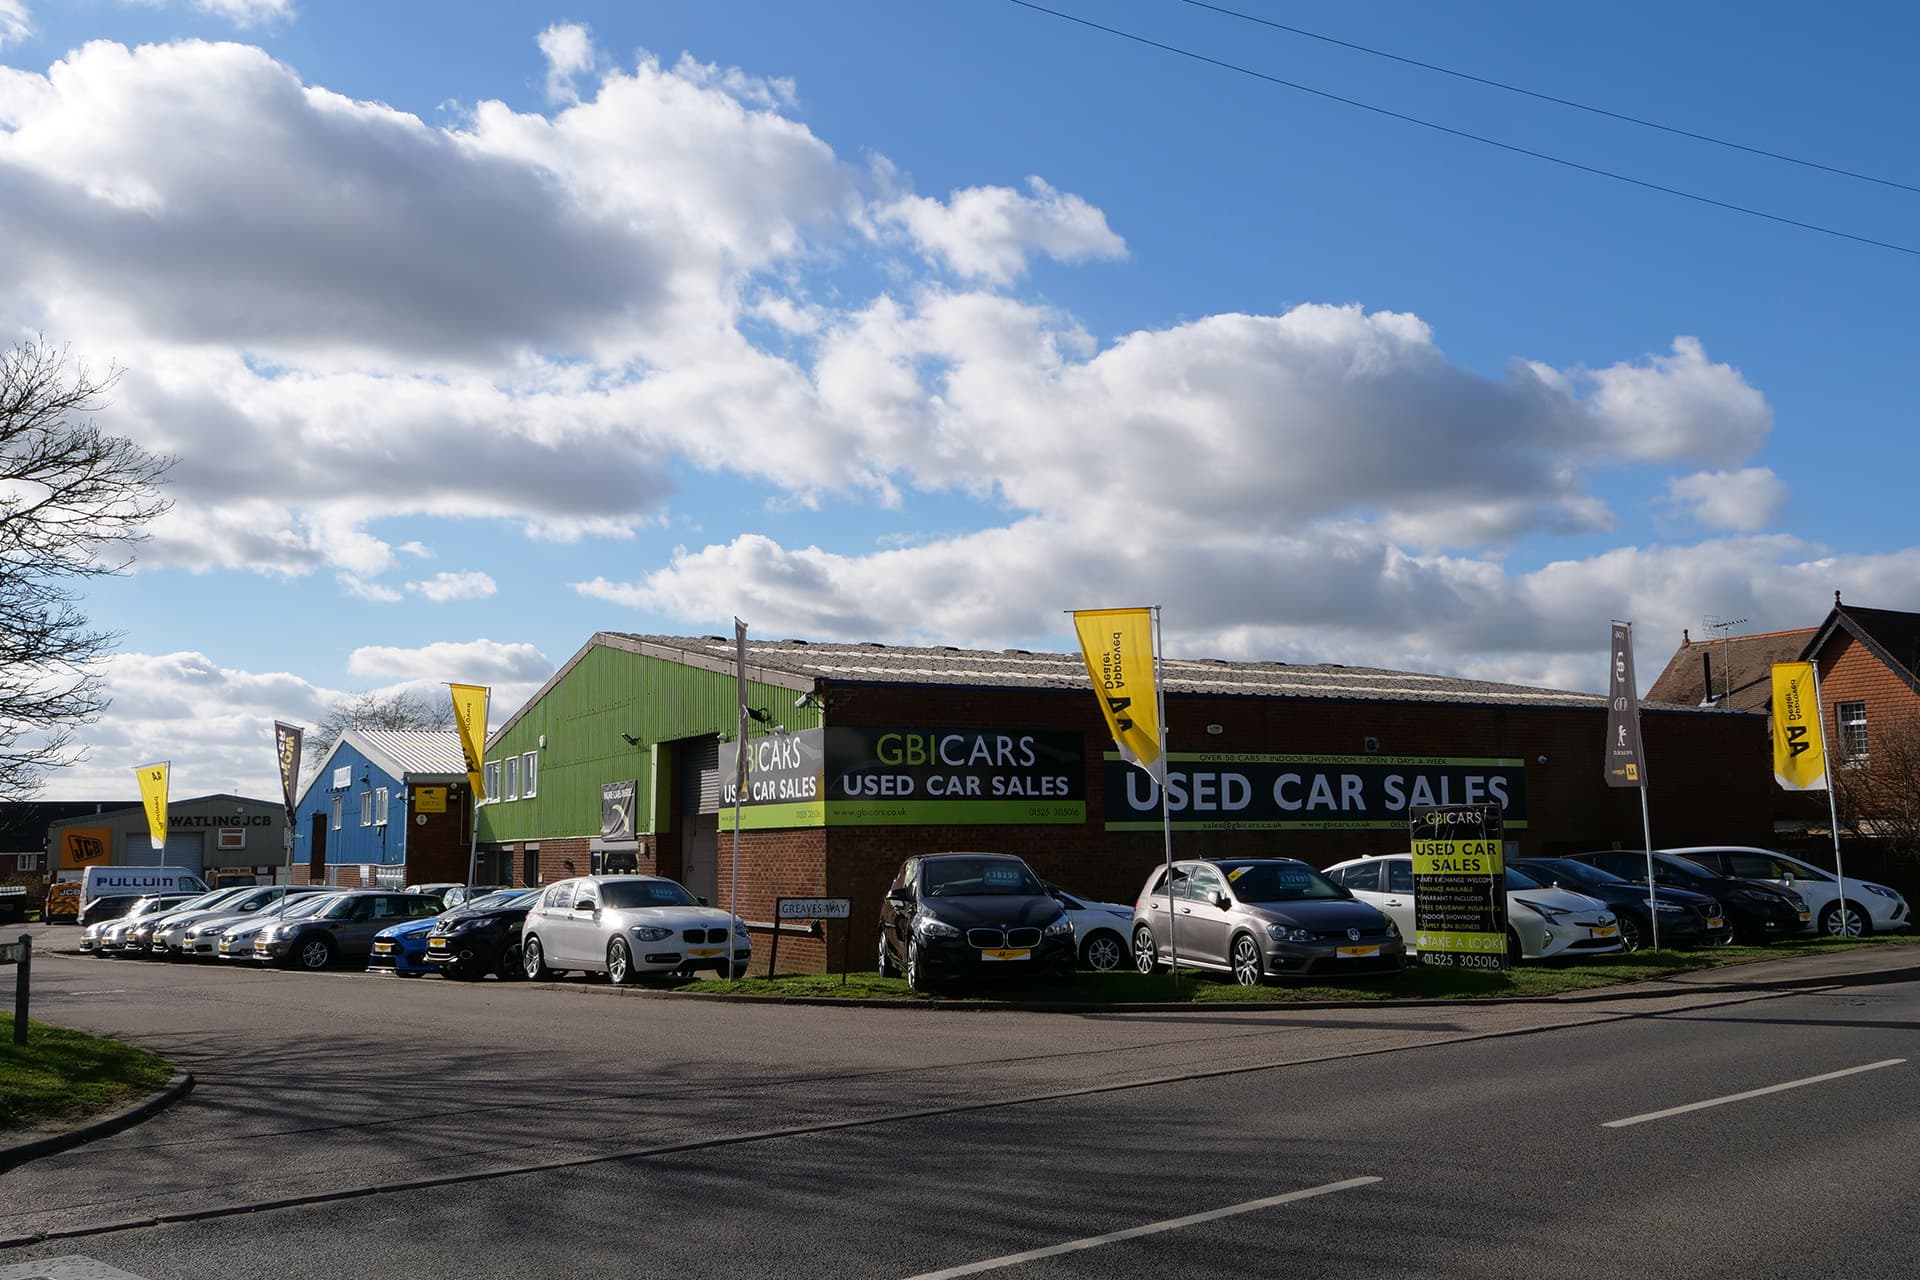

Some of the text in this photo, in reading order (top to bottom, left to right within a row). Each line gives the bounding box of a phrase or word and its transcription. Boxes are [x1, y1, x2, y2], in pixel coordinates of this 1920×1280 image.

[876, 733, 1036, 767] GBICARS
[753, 781, 776, 801] CAR
[780, 776, 817, 799] SALES
[843, 775, 1069, 796] USED CAR SALES
[1126, 771, 1510, 811] USED CAR SALES
[833, 808, 907, 818] www.gbicars.co.uk
[1028, 808, 1080, 817] 01525 305016
[1425, 812, 1481, 825] GBICARS
[167, 815, 272, 827] WATLING JCB
[74, 838, 103, 860] JCB
[1415, 842, 1497, 856] USED CAR
[1432, 858, 1481, 872] SALES
[782, 903, 848, 913] GREAVES WAY
[1427, 936, 1452, 947] TAKE
[1456, 937, 1464, 948] A
[1423, 953, 1500, 968] 01525 305016
